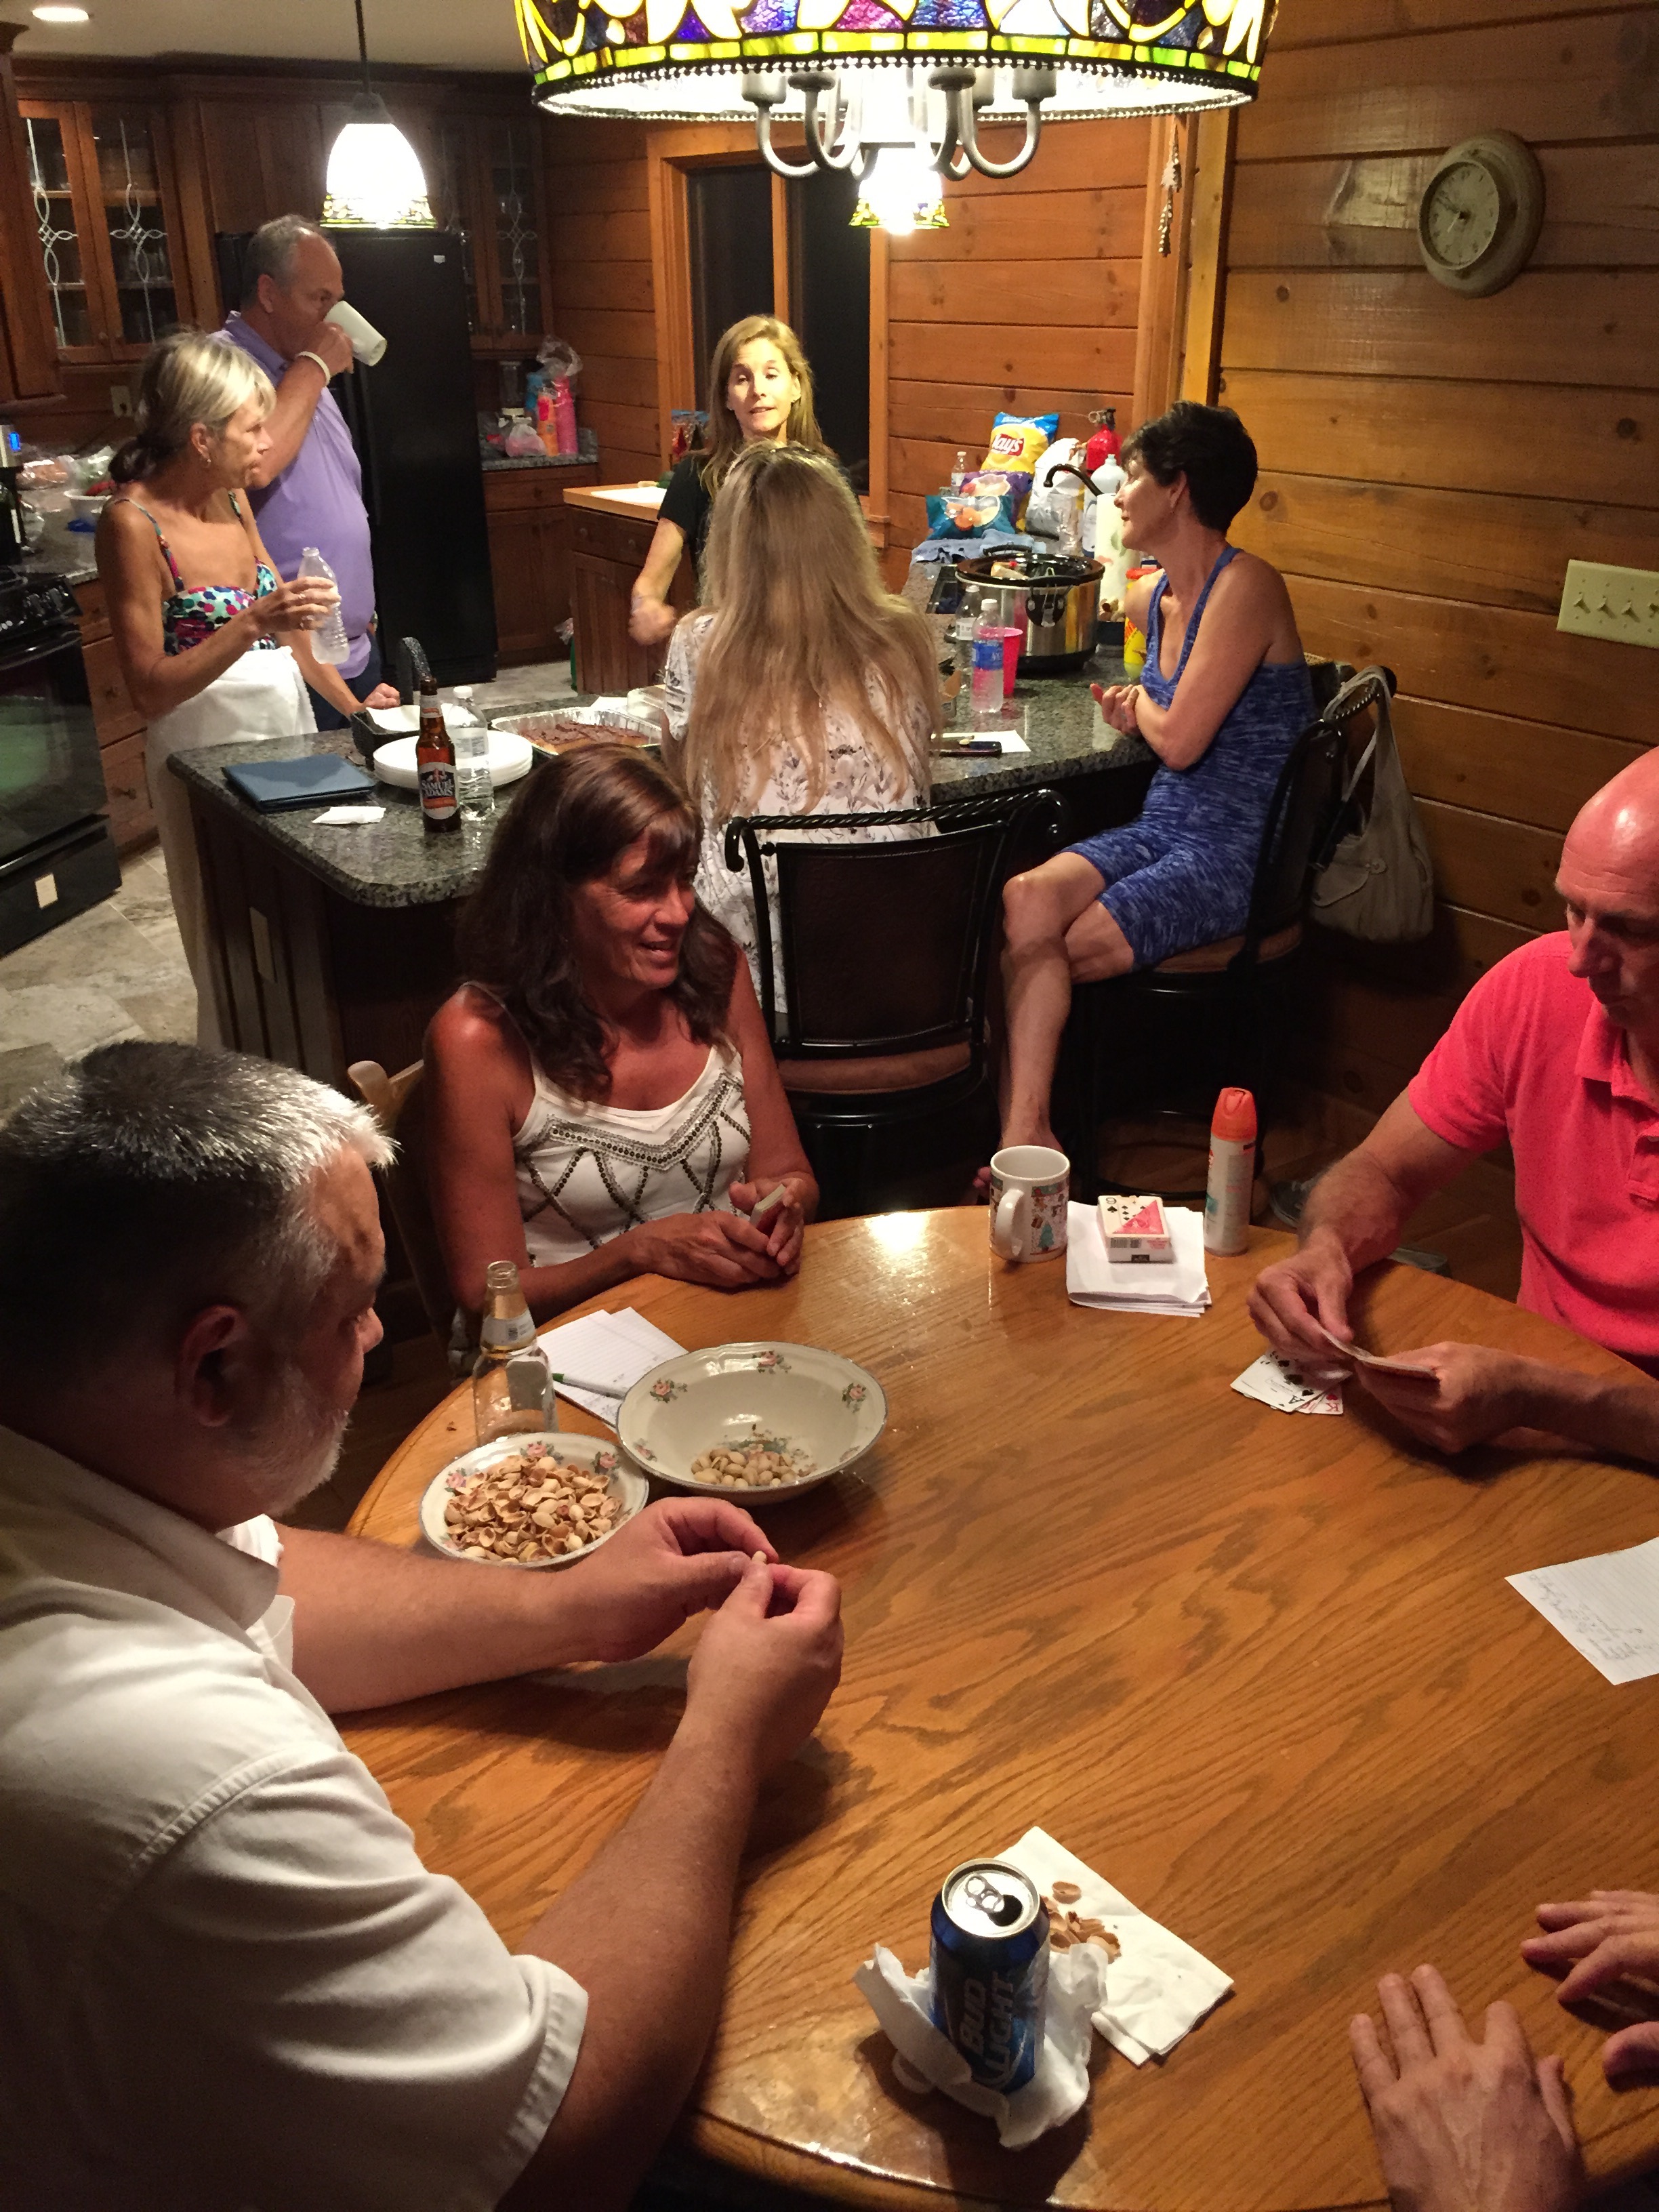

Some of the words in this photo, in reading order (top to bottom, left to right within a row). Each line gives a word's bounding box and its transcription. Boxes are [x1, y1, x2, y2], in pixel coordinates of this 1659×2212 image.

[1288, 1395, 1305, 1404] A
[1326, 1402, 1340, 1412] K
[960, 1978, 987, 2056] BUD
[985, 1971, 1014, 2074] LIGHT
